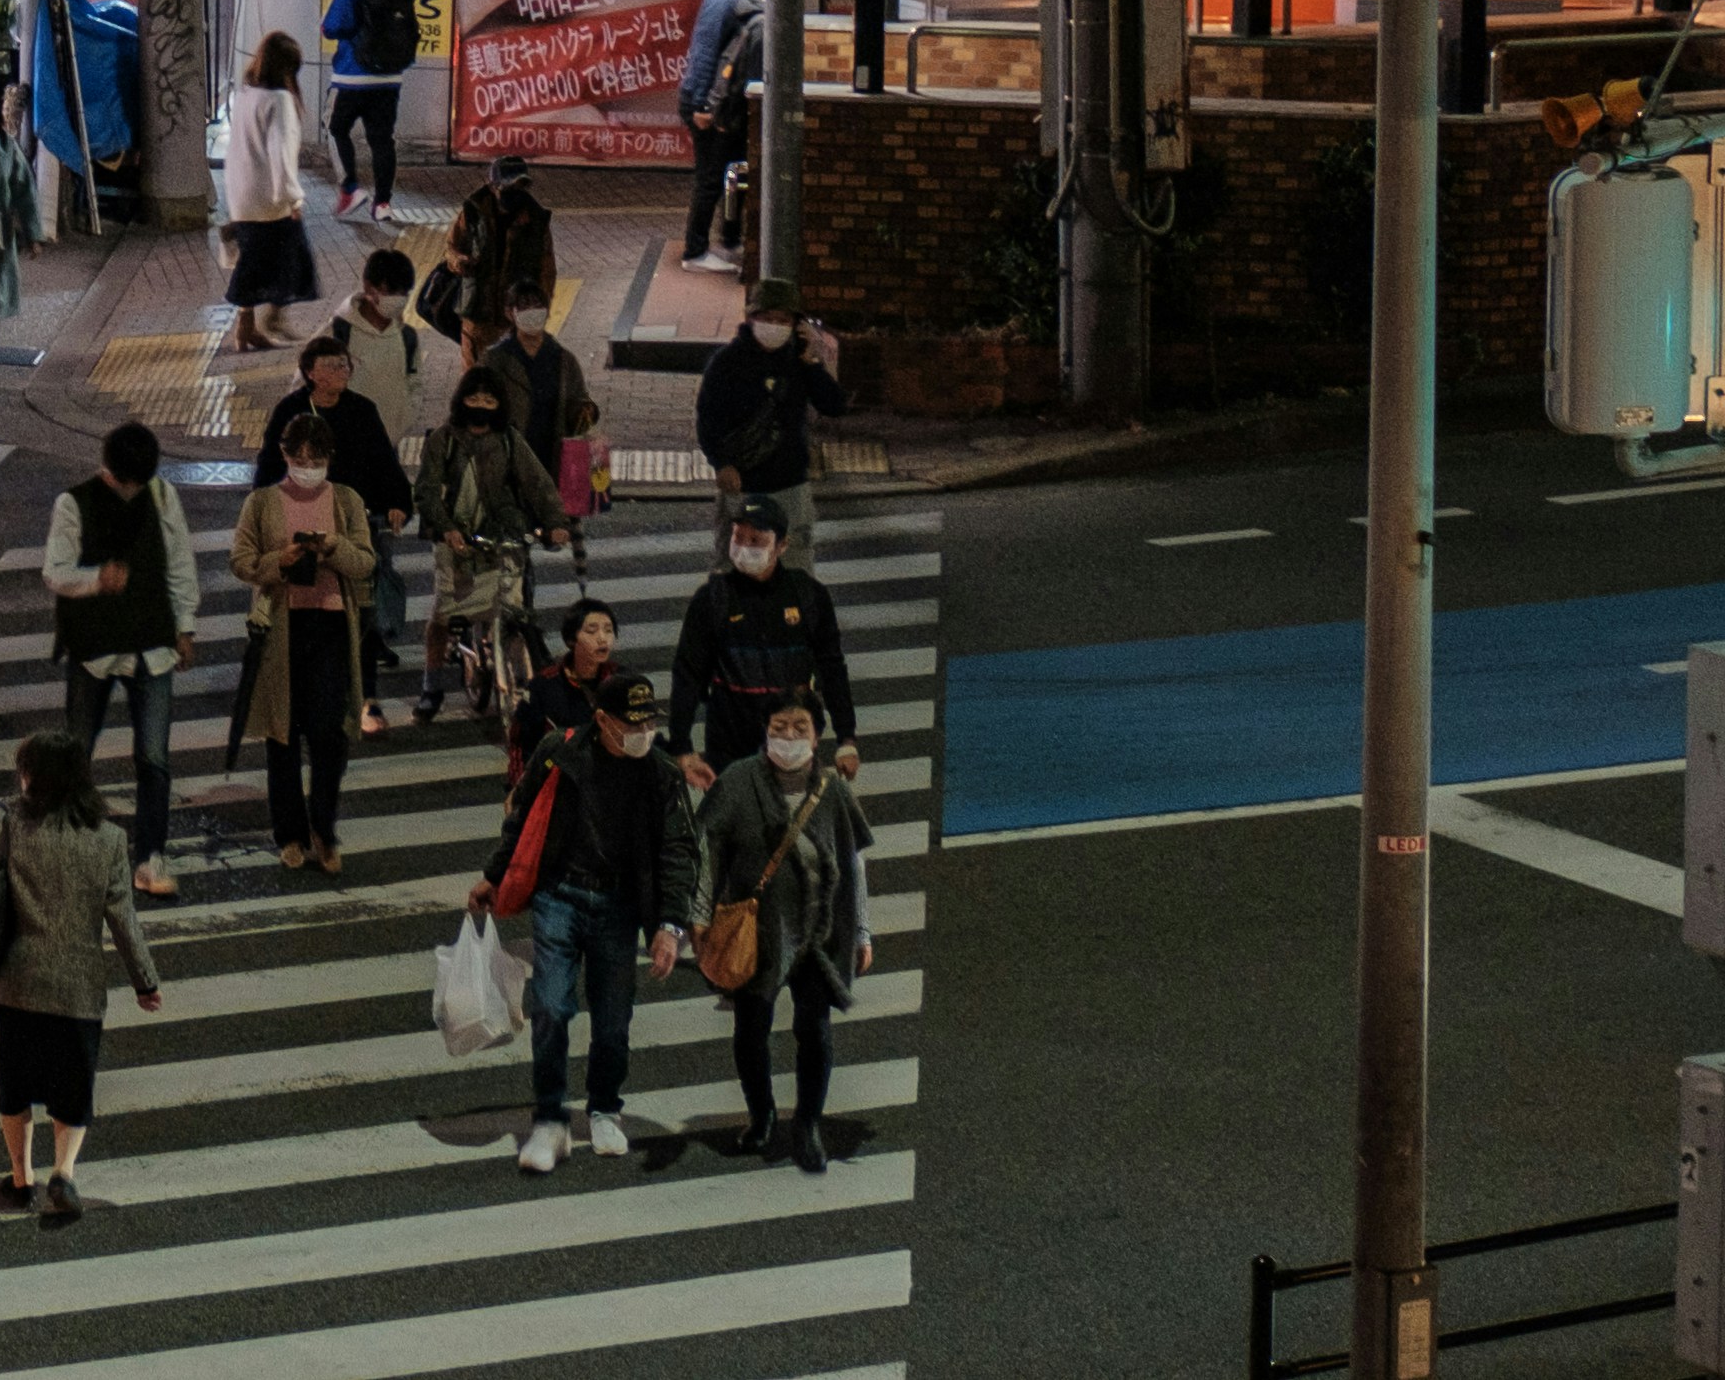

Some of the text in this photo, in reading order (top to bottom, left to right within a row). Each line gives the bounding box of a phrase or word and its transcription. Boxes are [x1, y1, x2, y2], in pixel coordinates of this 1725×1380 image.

[466, 25, 594, 81] 美魔女キャバクラ
[468, 126, 549, 150] DOUTOR
